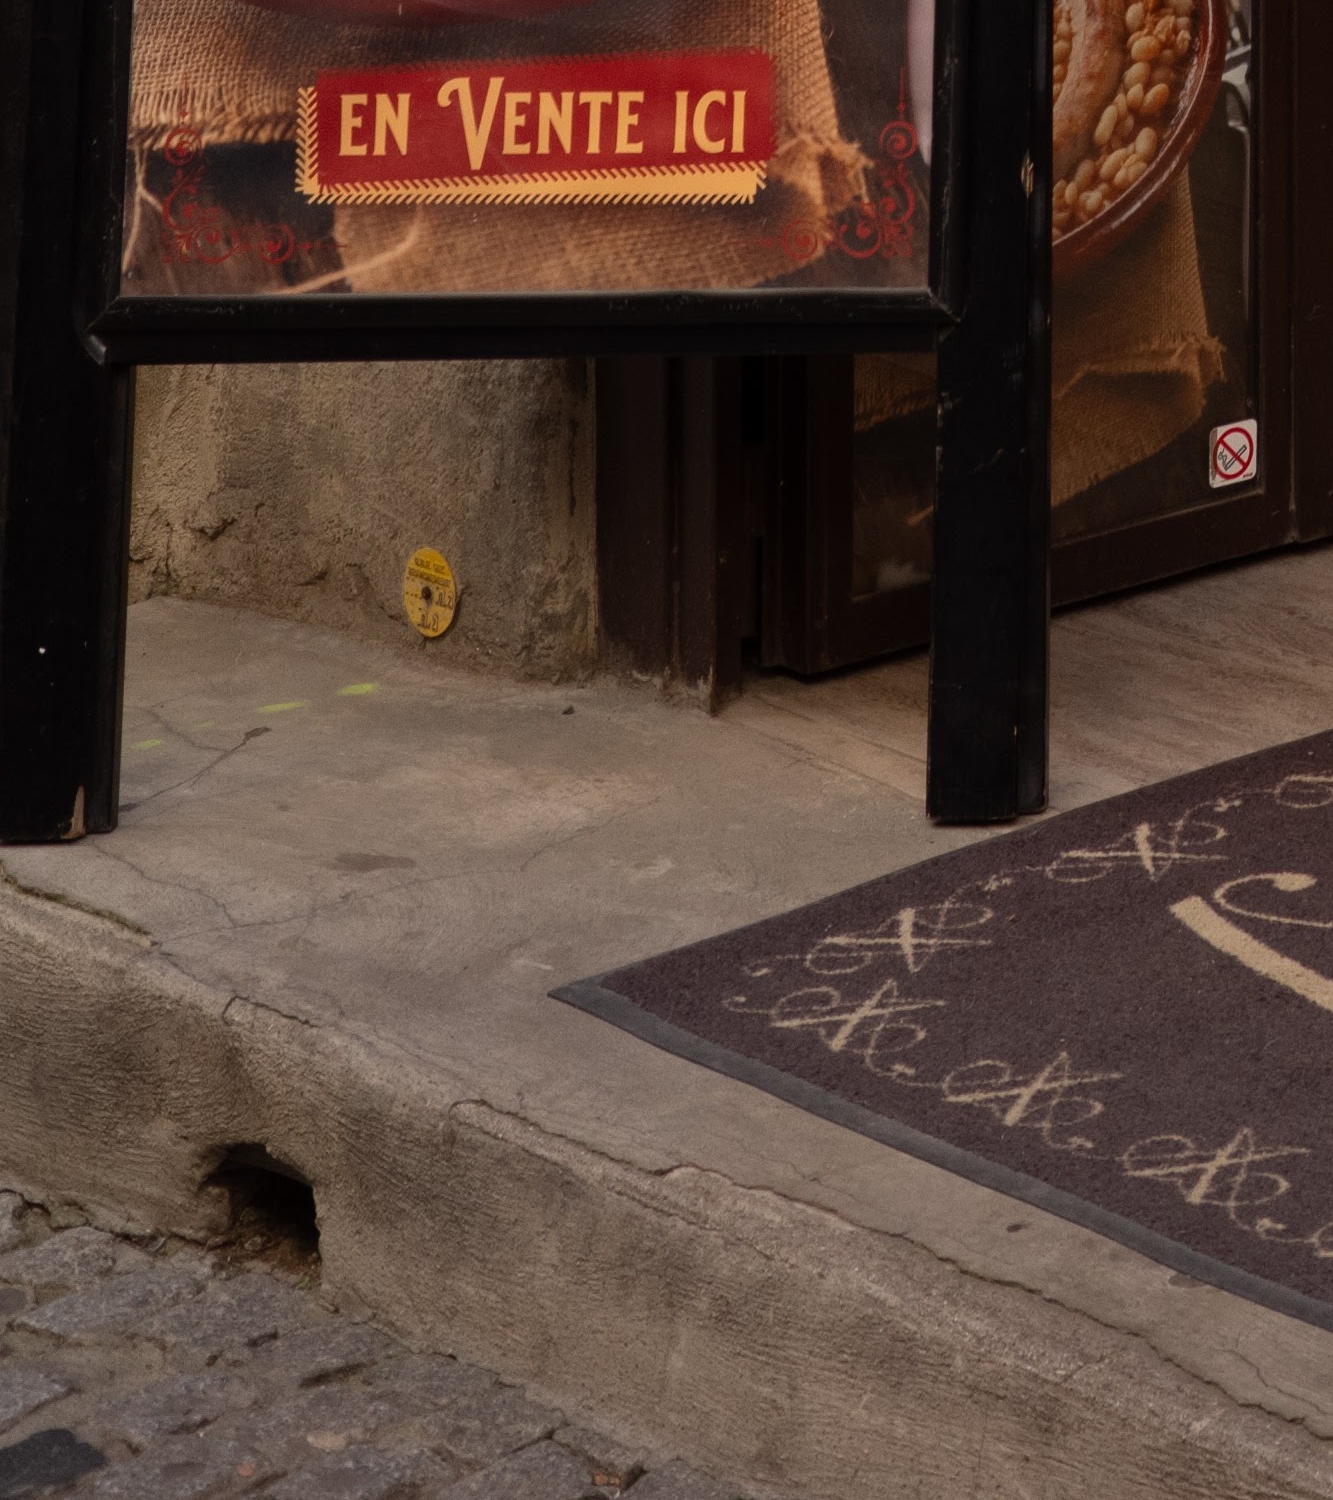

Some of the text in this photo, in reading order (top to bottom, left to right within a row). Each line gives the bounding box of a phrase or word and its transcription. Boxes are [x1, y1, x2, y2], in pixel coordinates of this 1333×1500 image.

[338, 75, 748, 173] EN VENTE ICI
